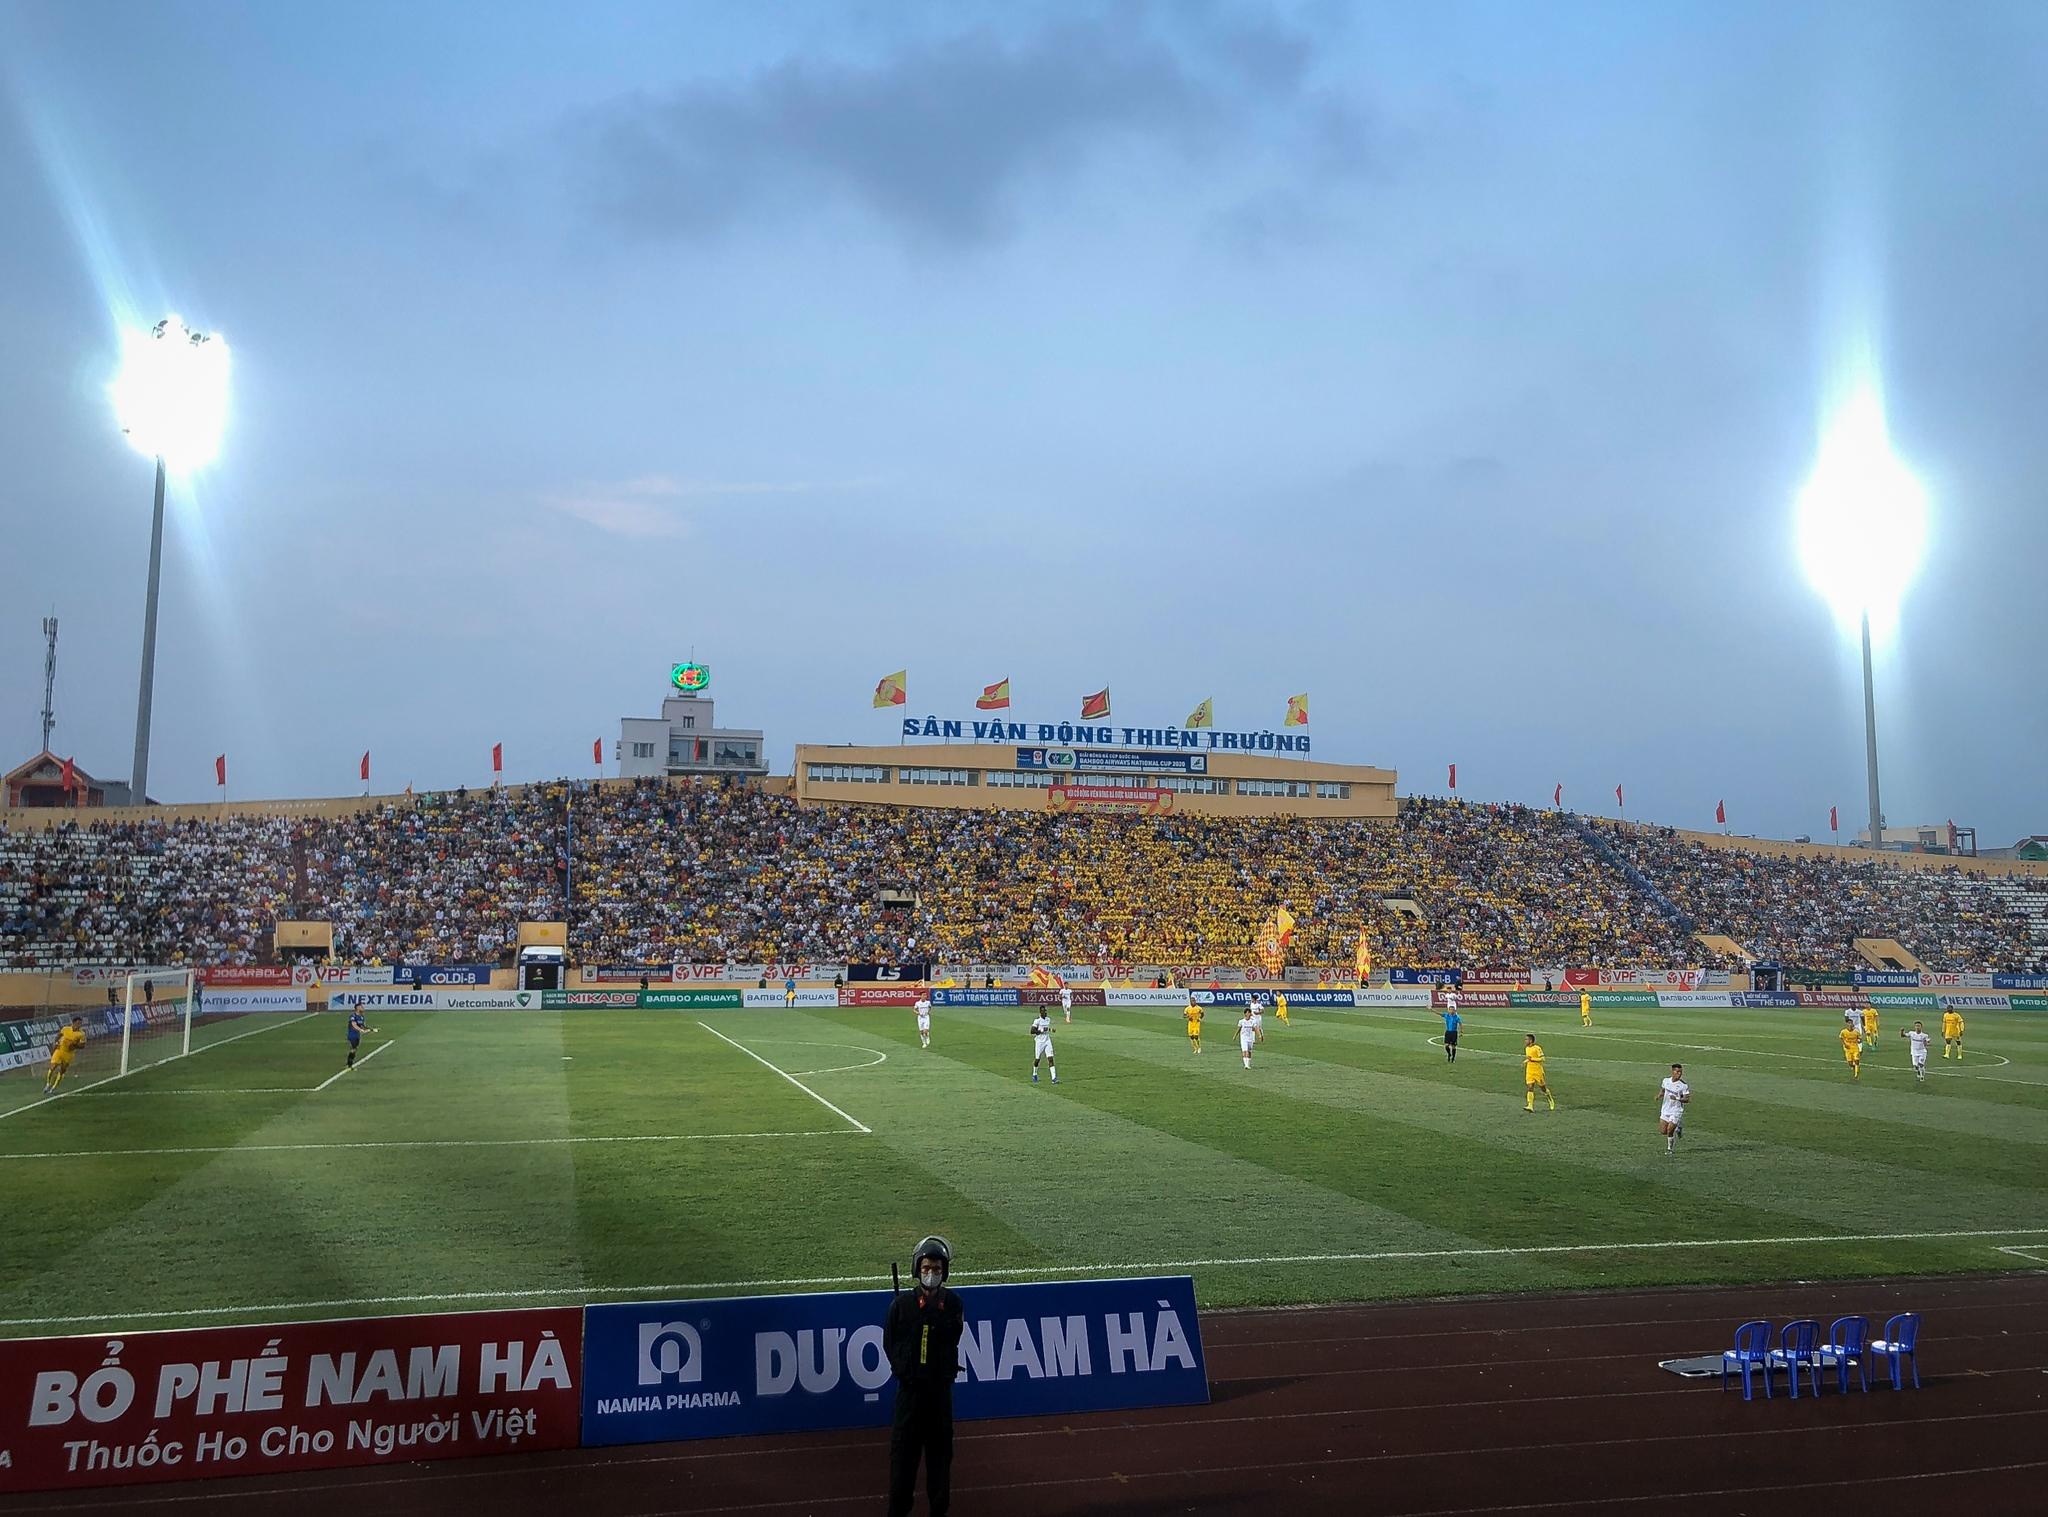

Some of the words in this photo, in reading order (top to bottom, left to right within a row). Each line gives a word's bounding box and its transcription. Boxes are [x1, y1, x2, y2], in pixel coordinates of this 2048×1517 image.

[903, 715, 961, 737] SÂN
[973, 718, 1026, 743] VẬN
[1038, 720, 1112, 746] ĐỘNG
[1121, 726, 1199, 748] THIÊN
[1207, 730, 1310, 751] TRƯỜNG
[212, 968, 290, 979] JOGARBOLA
[316, 967, 350, 981] VPF
[692, 966, 724, 978] VPF
[780, 966, 812, 978] VPF
[876, 967, 901, 981] LS
[1080, 971, 1090, 980] HÀ
[1107, 966, 1135, 978] VPF
[1184, 966, 1211, 979] VPF
[1613, 970, 1636, 981] VPF
[1679, 972, 1695, 982] VP
[1866, 974, 1887, 984] DƯỢC
[1888, 975, 1906, 984] NAM
[1906, 974, 1918, 984] HÀ
[1934, 974, 1960, 985] VPF
[2033, 976, 2048, 988] HIẾ
[348, 994, 385, 1005] NEXT
[392, 994, 434, 1005] MEDIA
[567, 992, 637, 1004] MIKADO
[646, 994, 690, 1002] BAMBOO
[694, 994, 738, 1002] AIRWAYS
[860, 990, 922, 998] JOGARBOL
[966, 994, 989, 1002] TRANG
[1038, 994, 1098, 1002] AGRANK
[1216, 992, 1270, 1001] BAMBOO
[1316, 994, 1332, 1002] CUP
[1333, 994, 1352, 1002] 2020
[1528, 994, 1580, 1002] MIKADO
[252, 996, 302, 1004] AIRWAYS
[448, 996, 516, 1008] Vietcombank
[1734, 998, 1742, 1006] 3
[1760, 996, 1774, 1006] THỂ
[1949, 996, 1974, 1005] NEXT
[1976, 997, 2008, 1006] MEDIA
[755, 1324, 893, 1401] DƯỢ
[954, 1314, 1092, 1383] NAM
[1104, 1299, 1197, 1373] HÀ
[29, 1340, 135, 1427] BỔ
[154, 1338, 289, 1418] PHẾ
[305, 1344, 461, 1407] NAM
[479, 1330, 573, 1394] HÀ
[597, 1397, 662, 1414] NAMHA
[666, 1391, 741, 1409] PHARMA
[63, 1428, 183, 1472] Thuốc
[195, 1430, 248, 1463] Ho
[260, 1425, 334, 1455] Cho
[347, 1412, 460, 1455] Người
[471, 1407, 537, 1444] Việt
